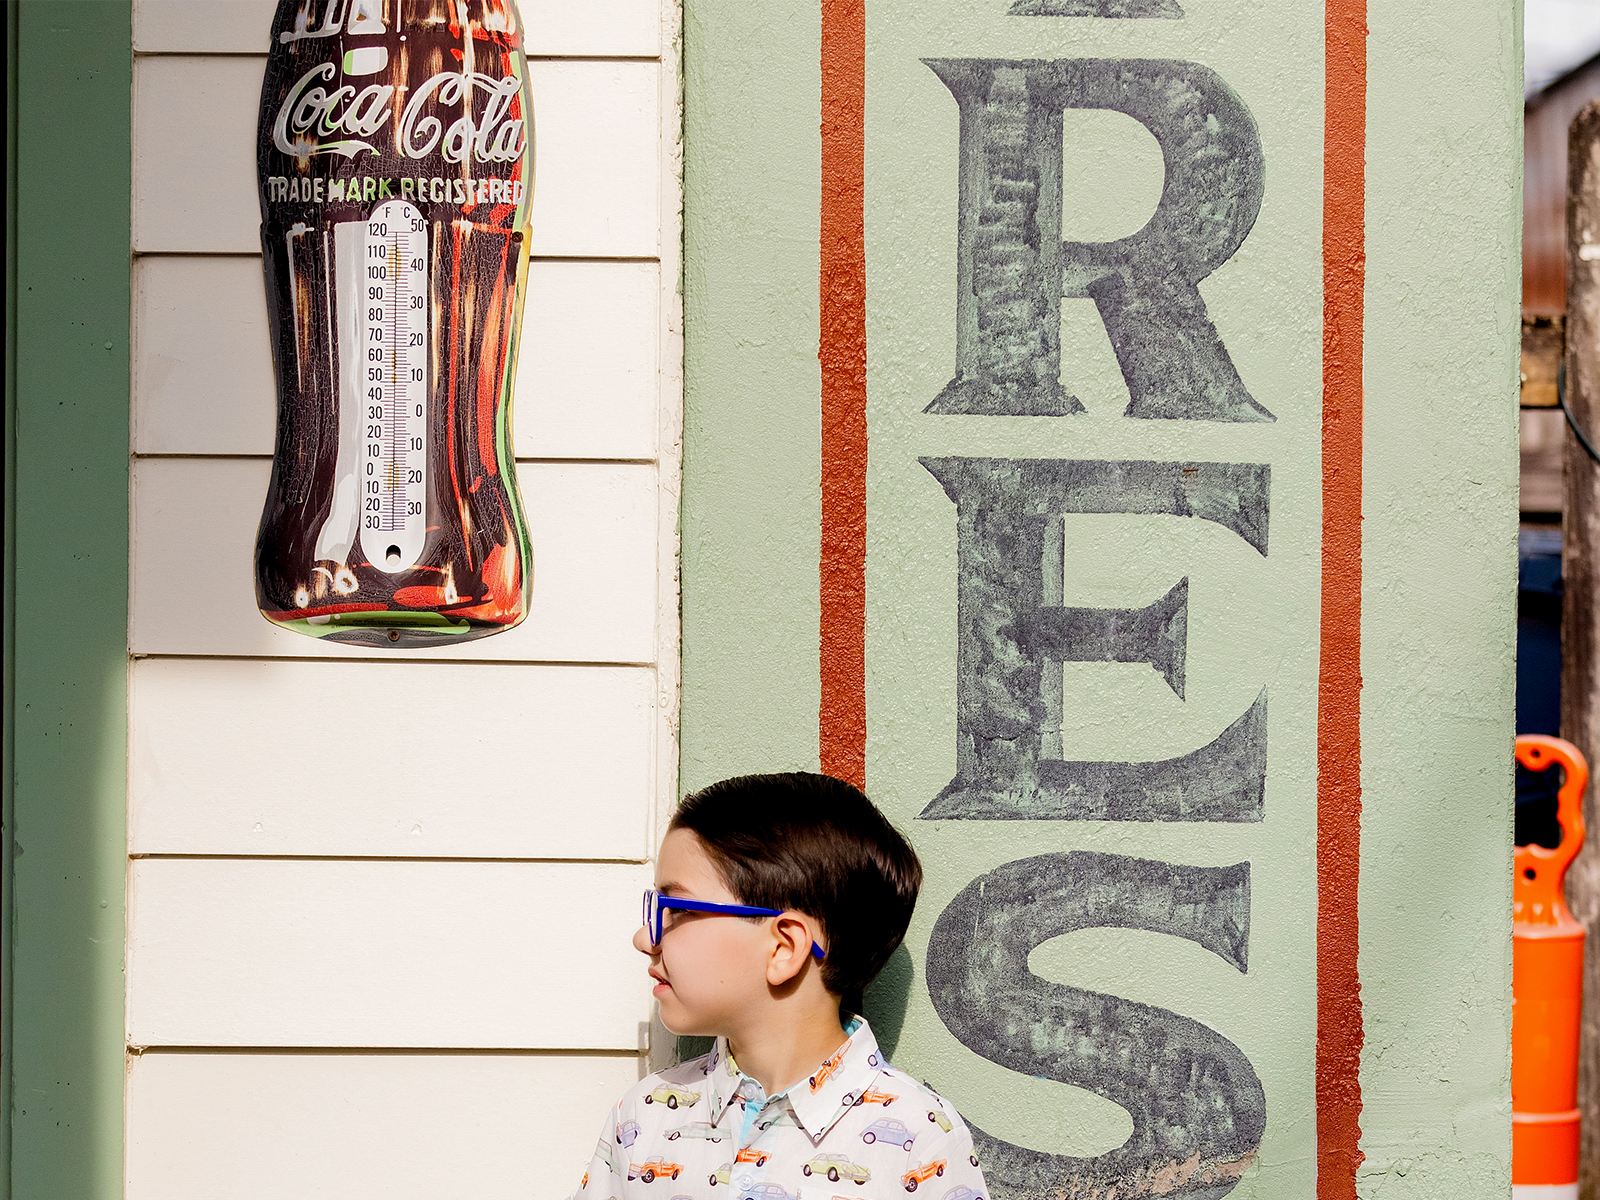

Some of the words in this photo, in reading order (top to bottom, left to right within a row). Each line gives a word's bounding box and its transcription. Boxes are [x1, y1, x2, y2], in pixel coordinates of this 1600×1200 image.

[268, 176, 323, 202] TRADE
[329, 177, 393, 202] MARK
[401, 177, 525, 205] REGISTERED
[369, 223, 387, 236] 120
[411, 219, 424, 232] 50
[368, 245, 386, 258] 110
[411, 259, 424, 271] 40
[368, 266, 386, 279] 100
[369, 287, 383, 300] 90
[410, 296, 423, 309] 30
[369, 308, 383, 321] 80
[369, 328, 382, 341] 70
[410, 333, 423, 346] 20
[368, 349, 383, 361] 60
[368, 368, 382, 381] 50
[411, 369, 422, 381] 10
[368, 387, 382, 400] 40
[369, 406, 382, 419] 30
[416, 405, 422, 417] 0
[367, 425, 381, 438] 20
[410, 438, 422, 450] 10
[367, 445, 380, 457] 10
[367, 463, 373, 475] 0
[408, 470, 422, 483] 20
[367, 481, 379, 493] 10
[366, 498, 380, 511] 20
[408, 502, 421, 514] 30
[366, 516, 379, 529] 30
